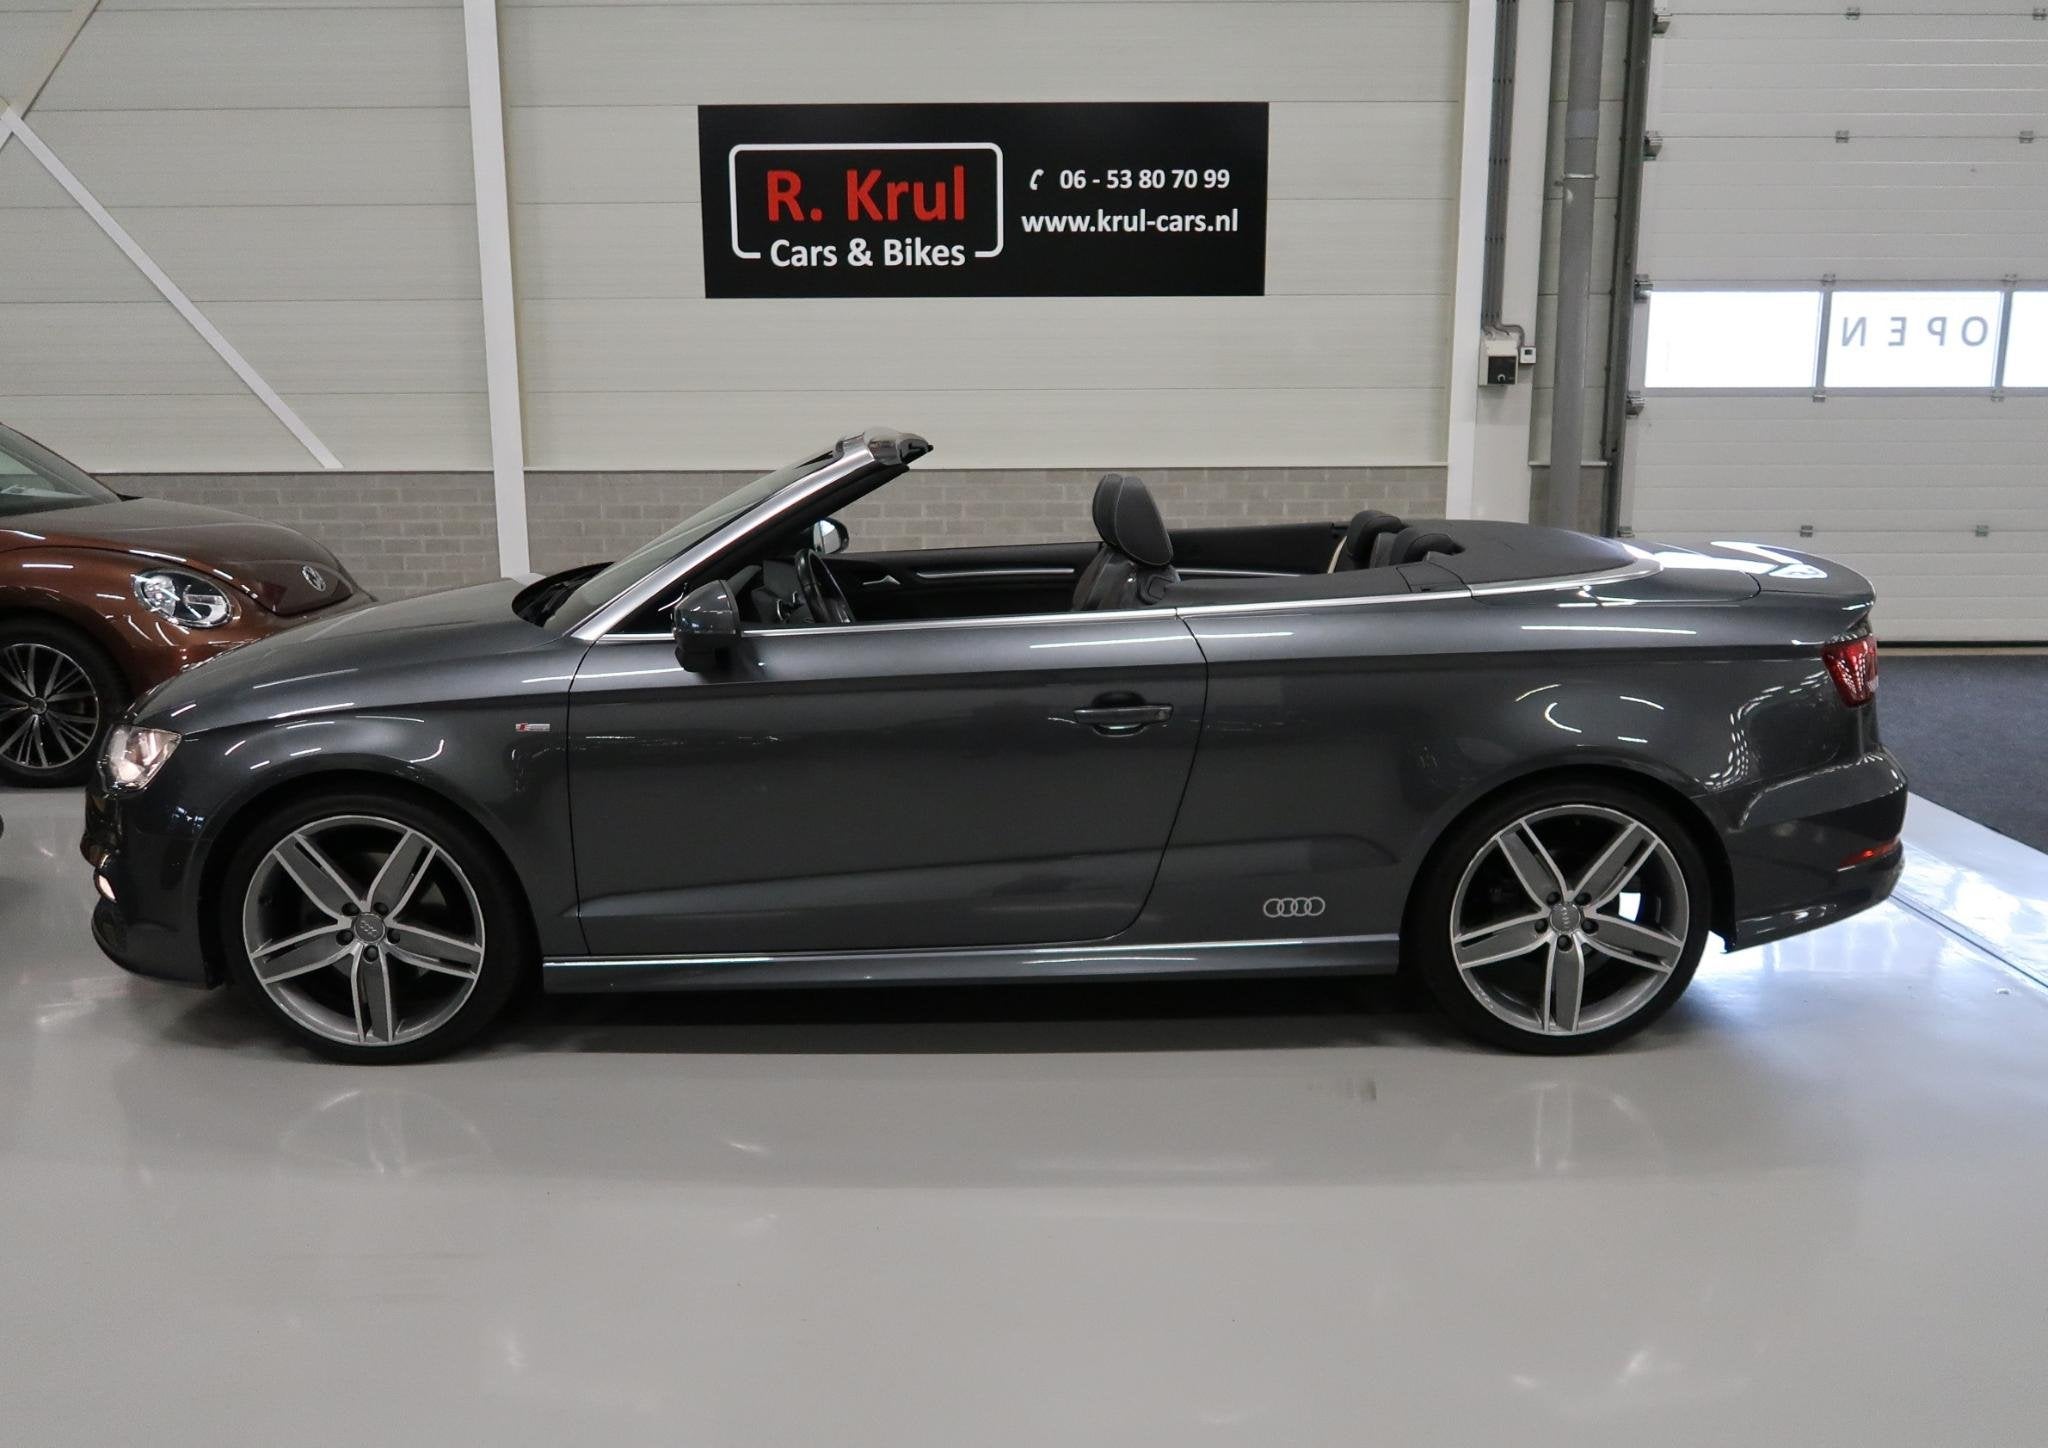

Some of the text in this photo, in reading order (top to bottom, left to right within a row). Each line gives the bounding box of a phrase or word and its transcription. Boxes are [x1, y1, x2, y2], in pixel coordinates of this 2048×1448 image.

[1059, 169, 1087, 190] 06
[1106, 169, 1133, 189] 53
[1138, 168, 1166, 189] 80
[1171, 168, 1198, 189] 70
[1203, 168, 1231, 189] 99
[767, 166, 965, 222] R. Krul
[1020, 208, 1239, 233] www.krul-cars.nl
[770, 237, 966, 268] Cars & Bikes
